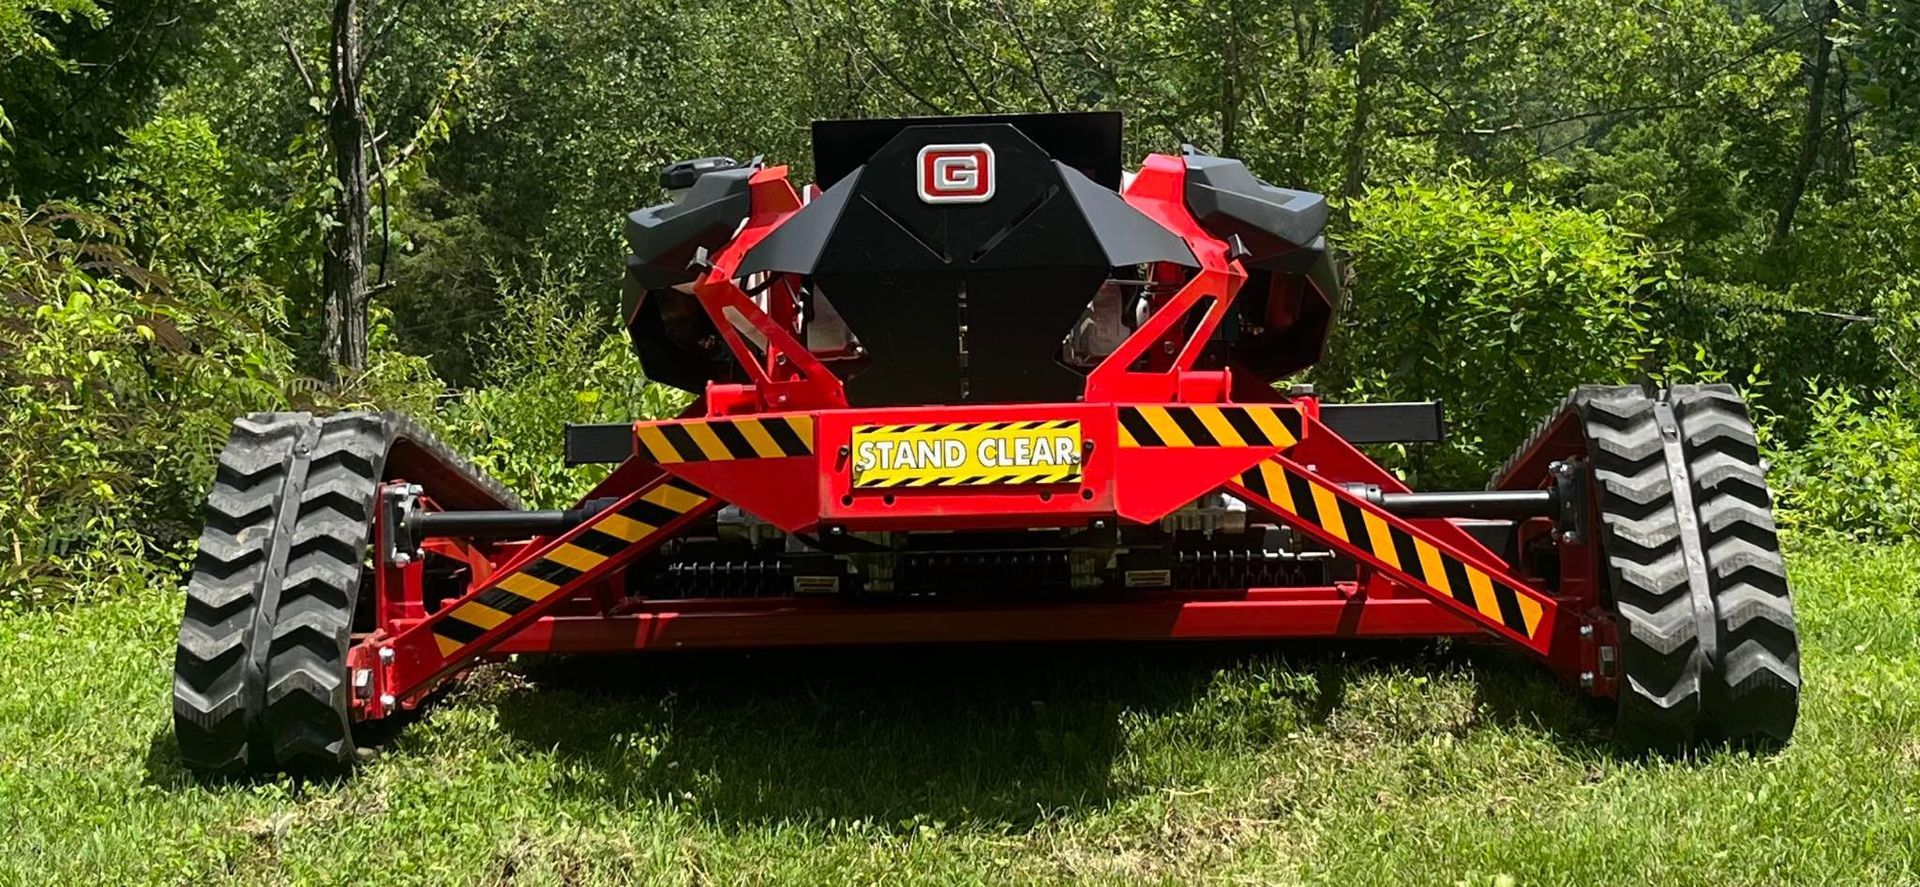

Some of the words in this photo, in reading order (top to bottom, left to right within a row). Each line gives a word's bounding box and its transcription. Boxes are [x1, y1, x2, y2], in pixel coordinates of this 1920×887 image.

[934, 155, 978, 191] G
[858, 440, 967, 470] STAND
[976, 436, 1074, 468] CLEAR
